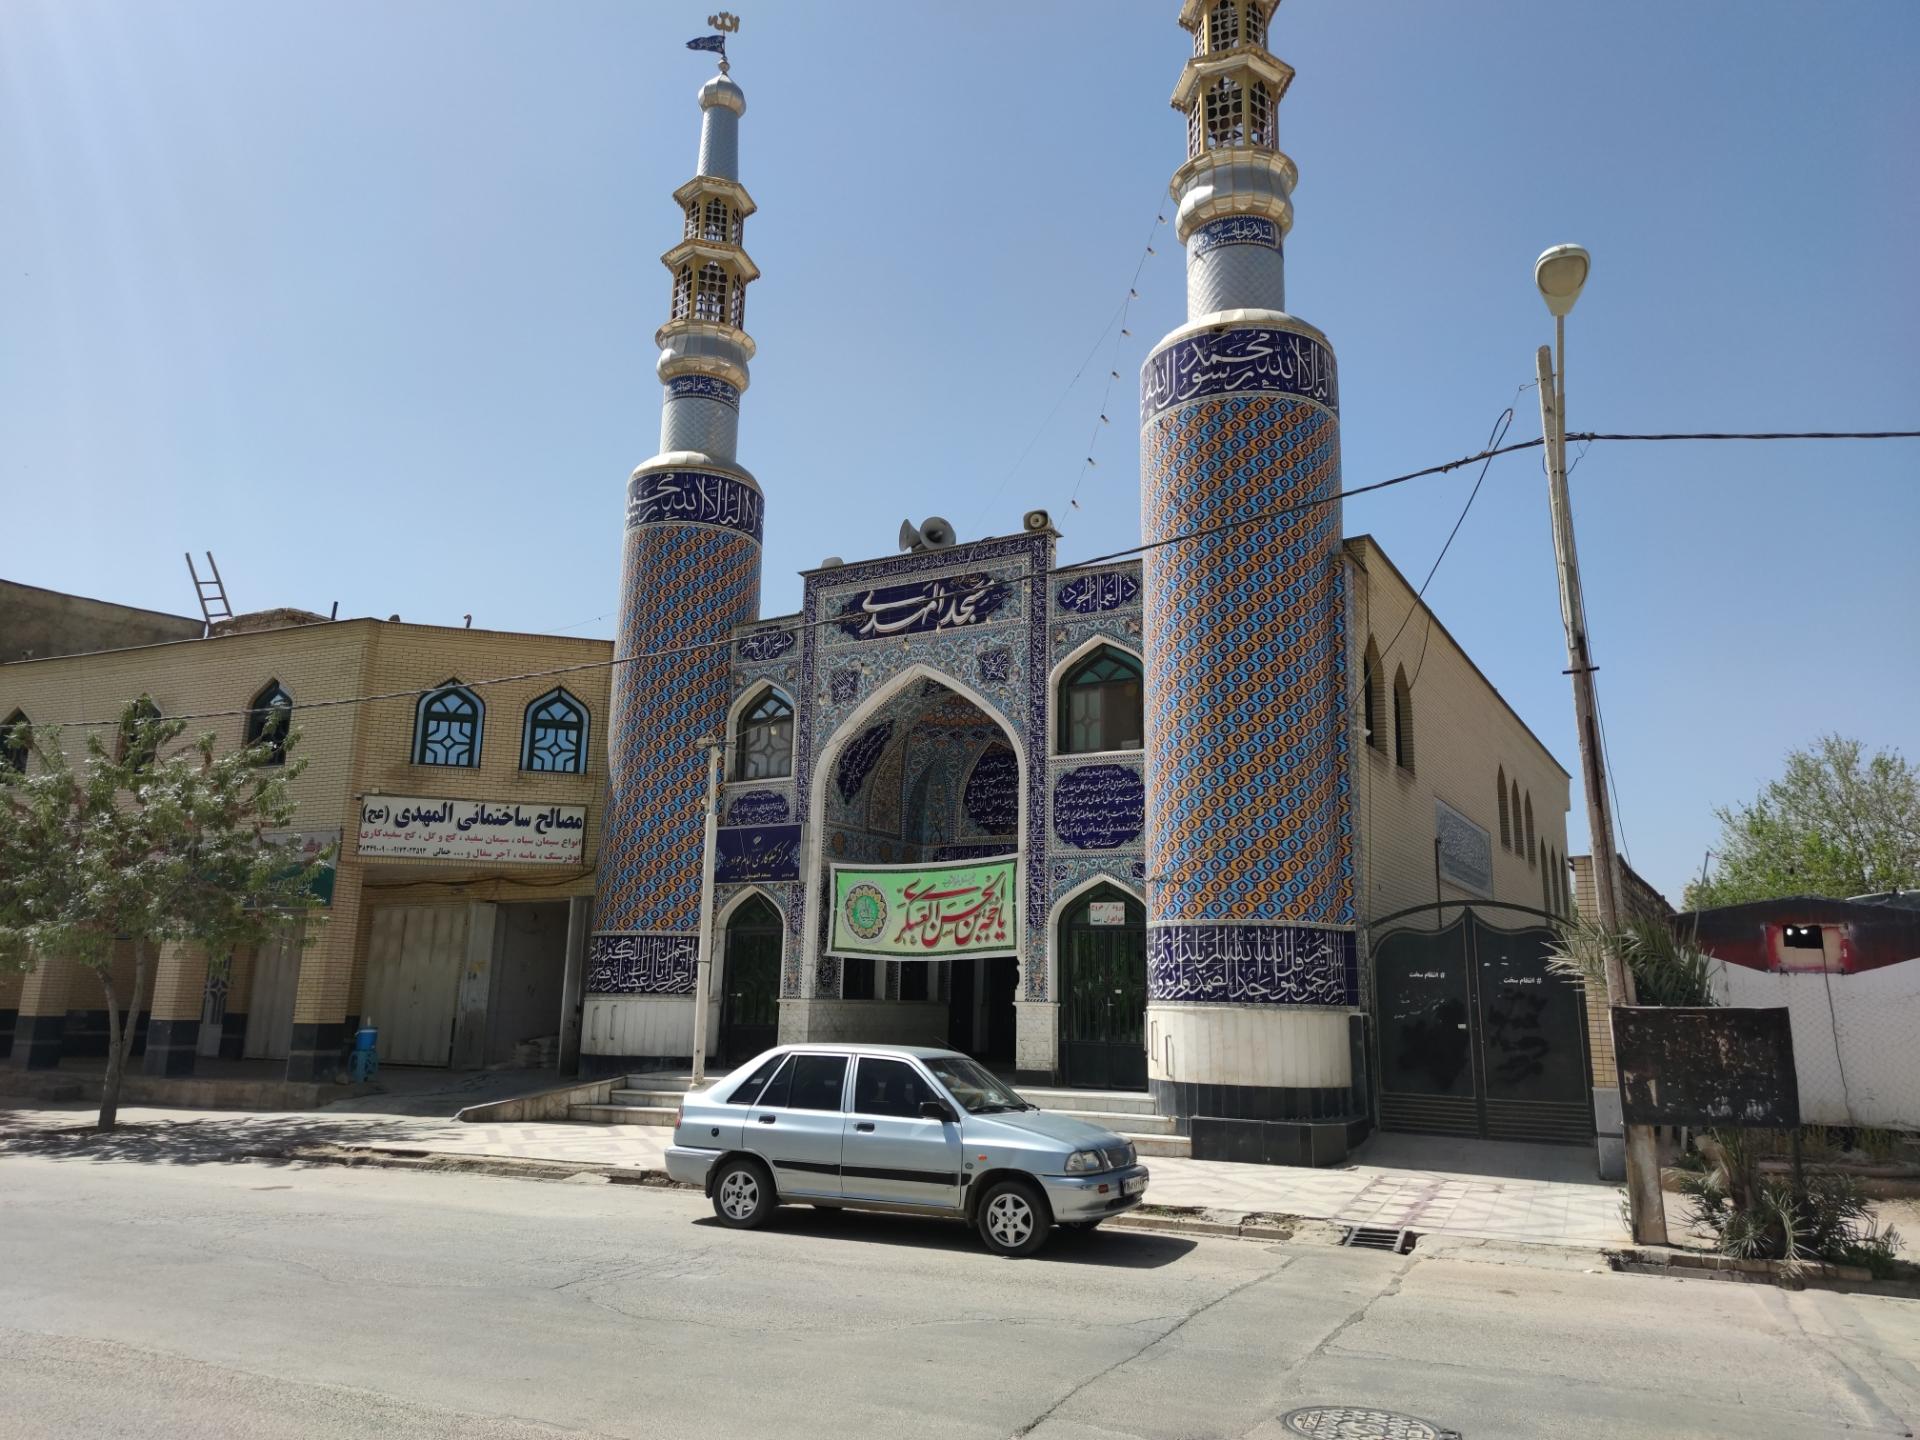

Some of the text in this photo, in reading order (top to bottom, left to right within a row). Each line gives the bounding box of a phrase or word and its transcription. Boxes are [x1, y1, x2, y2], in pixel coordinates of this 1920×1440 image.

[362, 801, 583, 834] مصالح ساختمانی المهدی (عج)
[464, 833, 483, 844] سفید
[486, 834, 508, 845] سیمان
[517, 835, 533, 844] سیاه
[536, 836, 559, 847] سیمان
[560, 838, 581, 848] انواع
